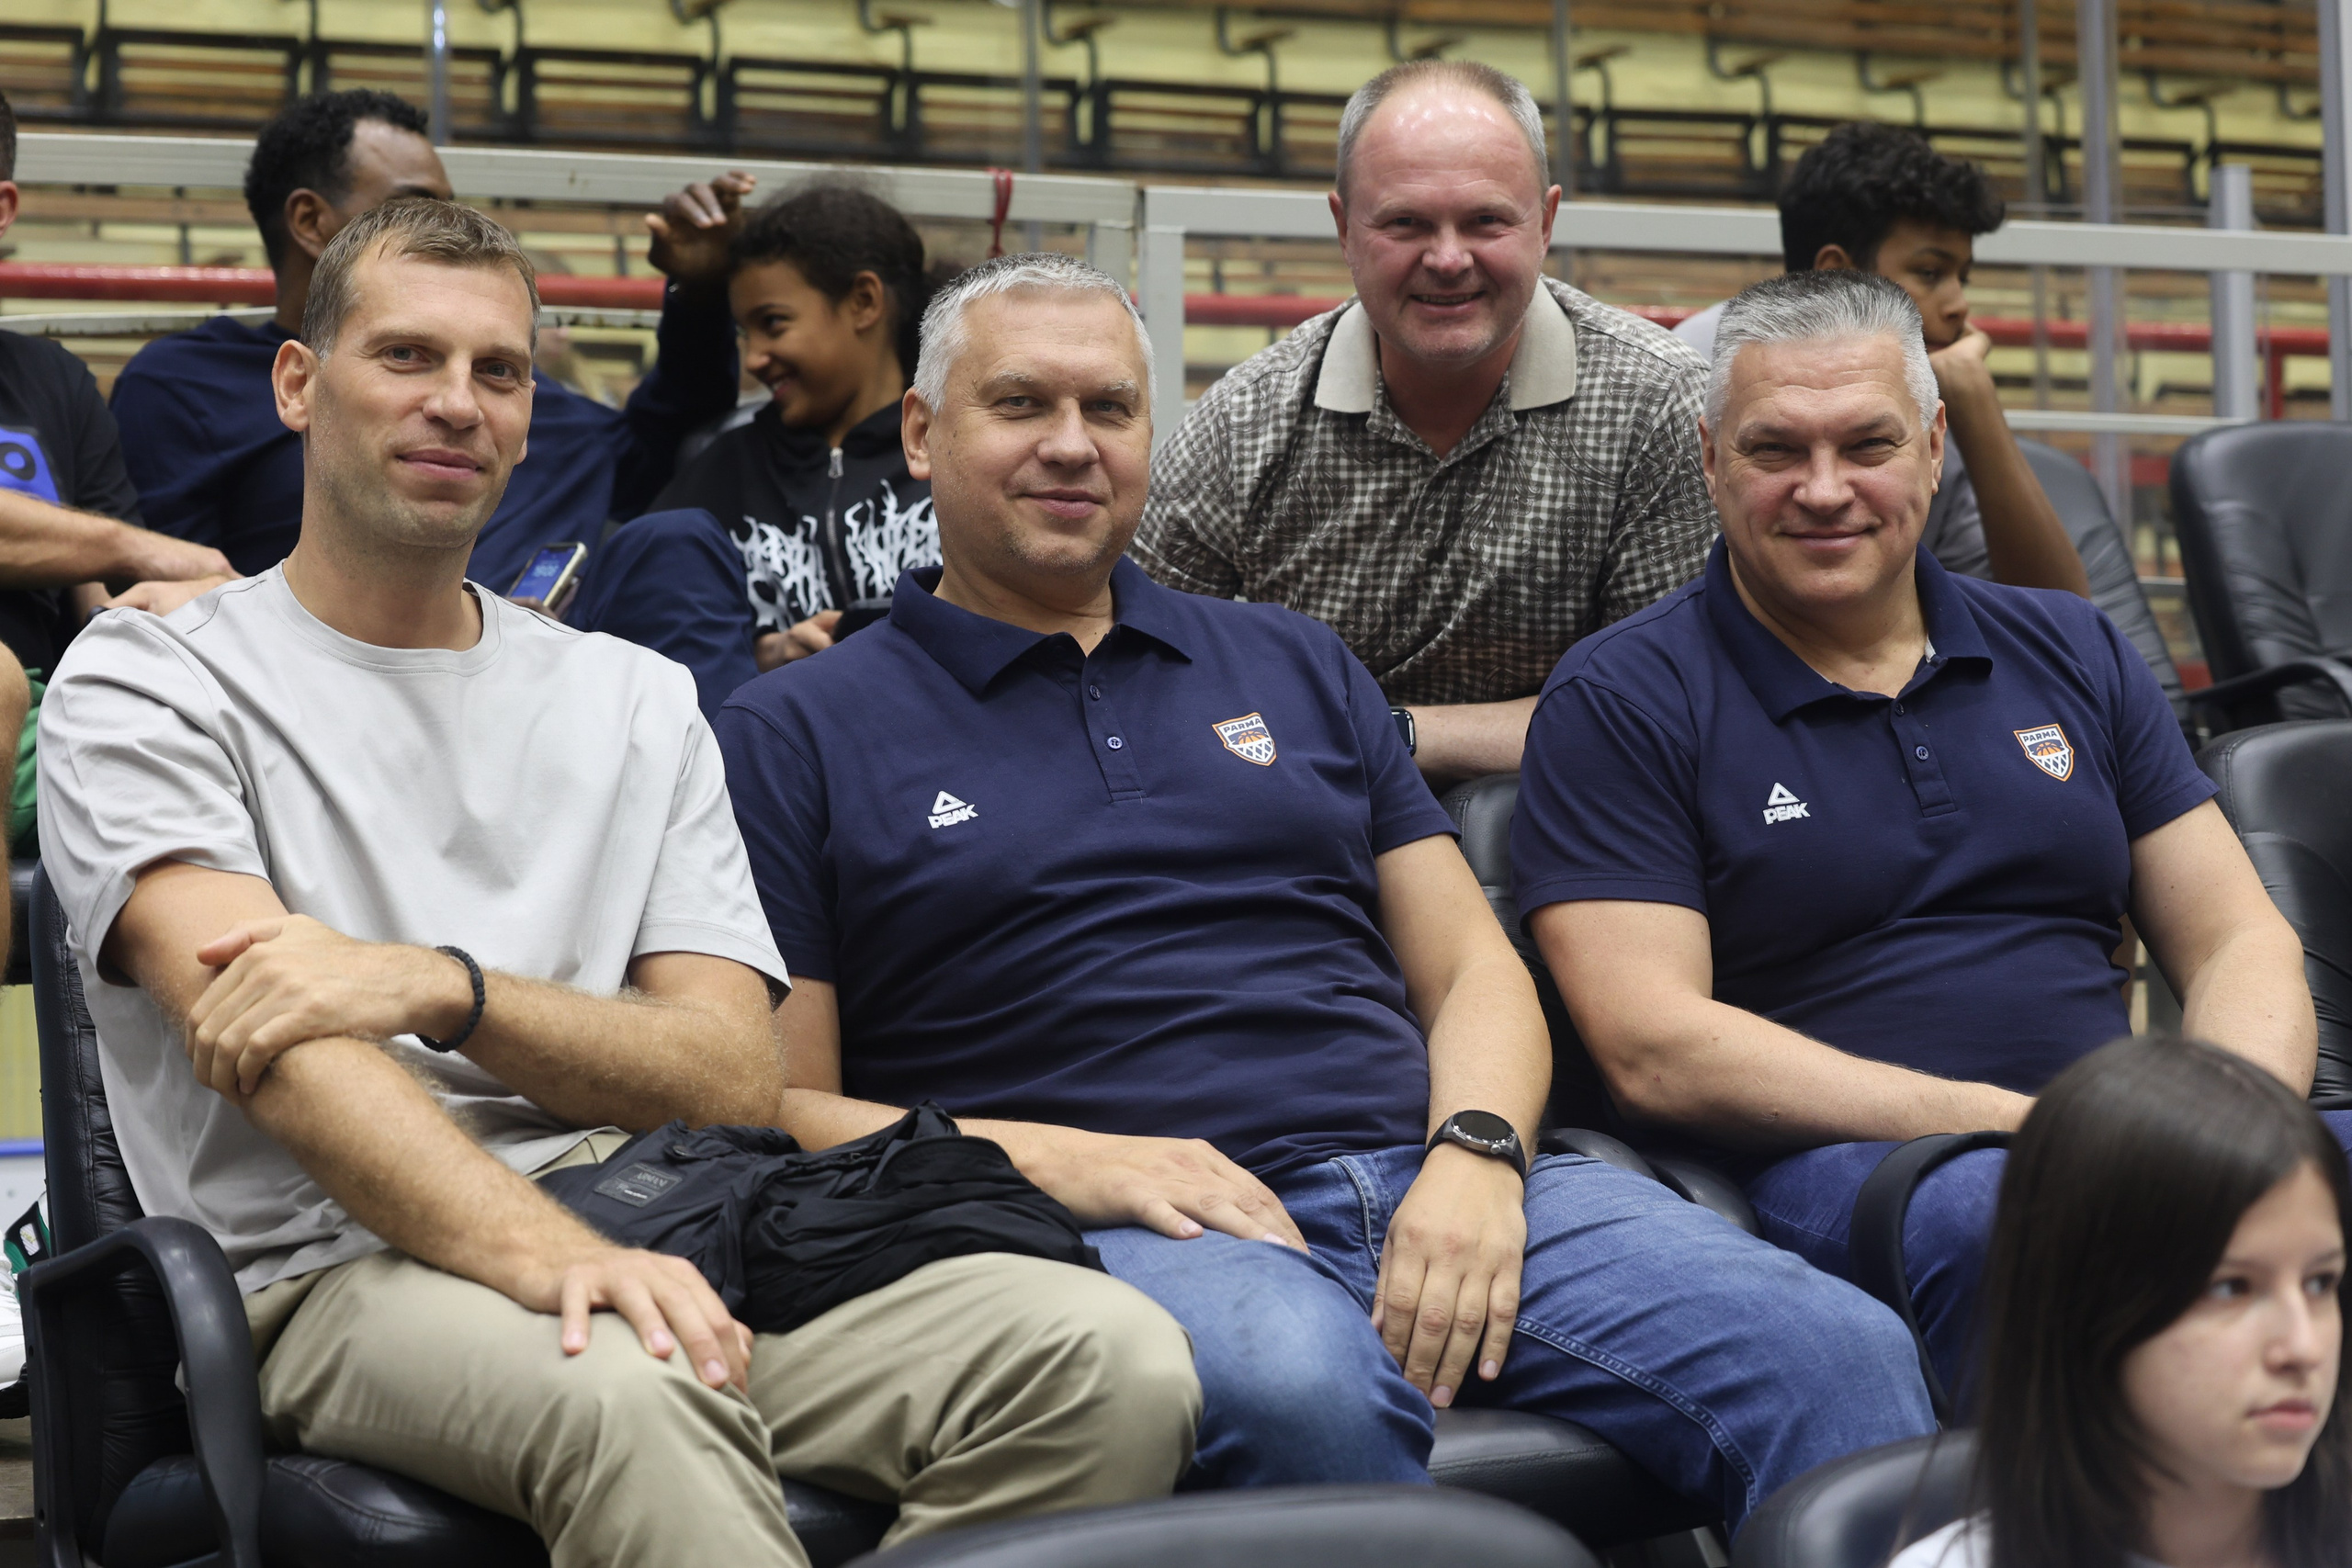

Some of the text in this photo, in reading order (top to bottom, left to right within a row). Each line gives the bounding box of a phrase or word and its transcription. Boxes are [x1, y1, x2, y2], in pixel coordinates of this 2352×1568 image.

[1223, 717, 1262, 733] PARMA
[2022, 730, 2058, 742] PARMA
[927, 804, 979, 829] PEAK
[1762, 802, 1811, 825] PEAK
